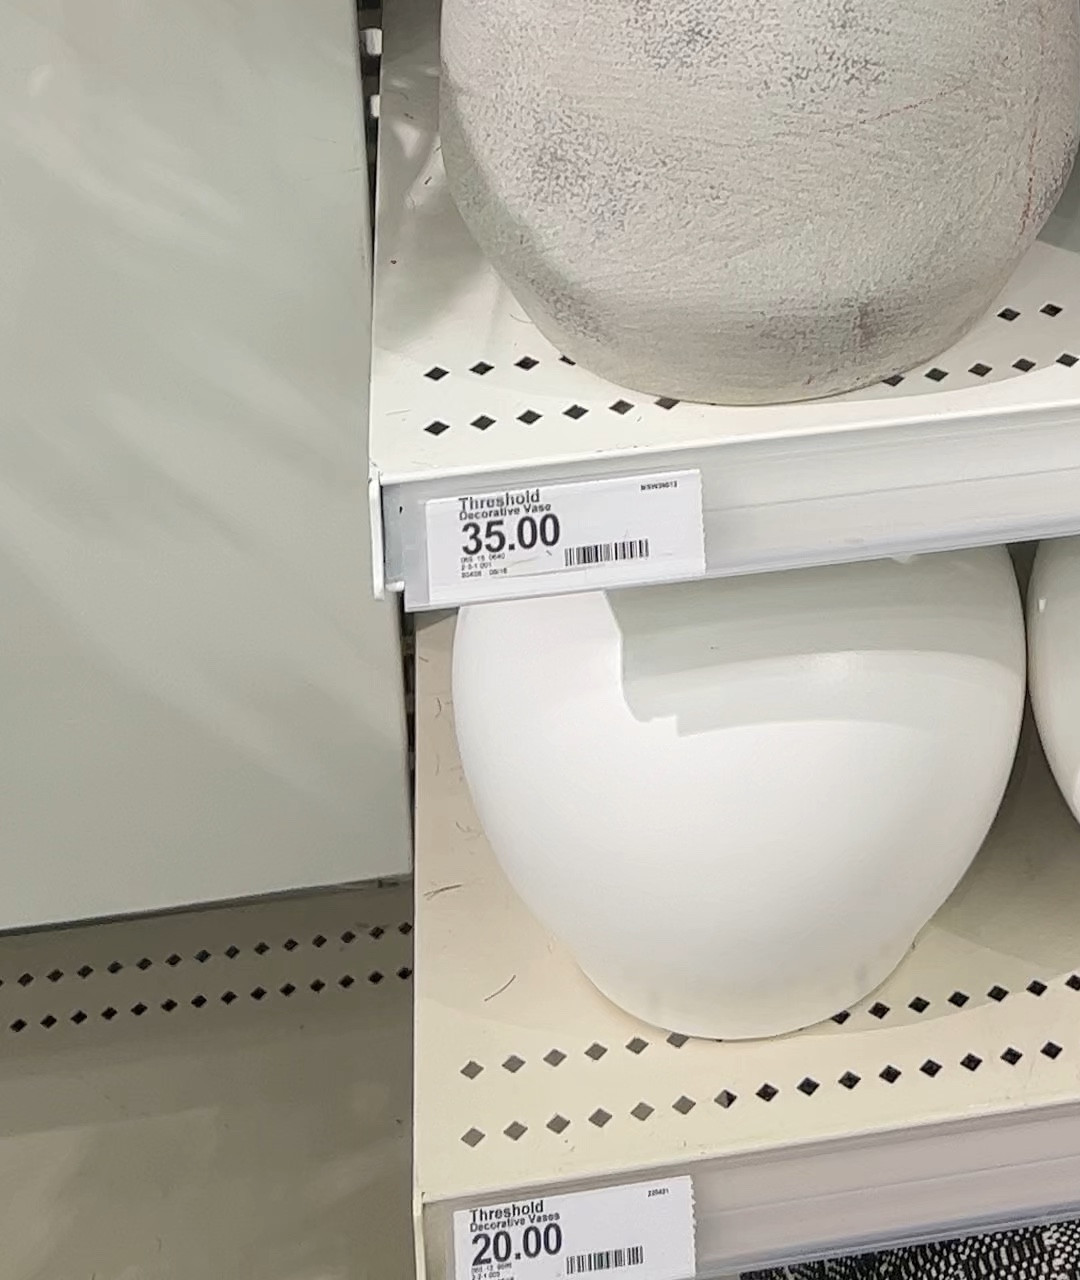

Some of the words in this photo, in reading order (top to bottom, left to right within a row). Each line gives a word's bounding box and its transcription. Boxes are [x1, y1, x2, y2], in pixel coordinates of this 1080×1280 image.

[459, 489, 540, 511] Threshold
[459, 507, 520, 521] Decorative
[524, 503, 551, 514] Vase
[462, 513, 560, 555] 35.00
[469, 1200, 544, 1223] Threshold
[470, 1217, 526, 1233] Decorative
[529, 1212, 561, 1225] Vases
[472, 1222, 563, 1267] 20.00
